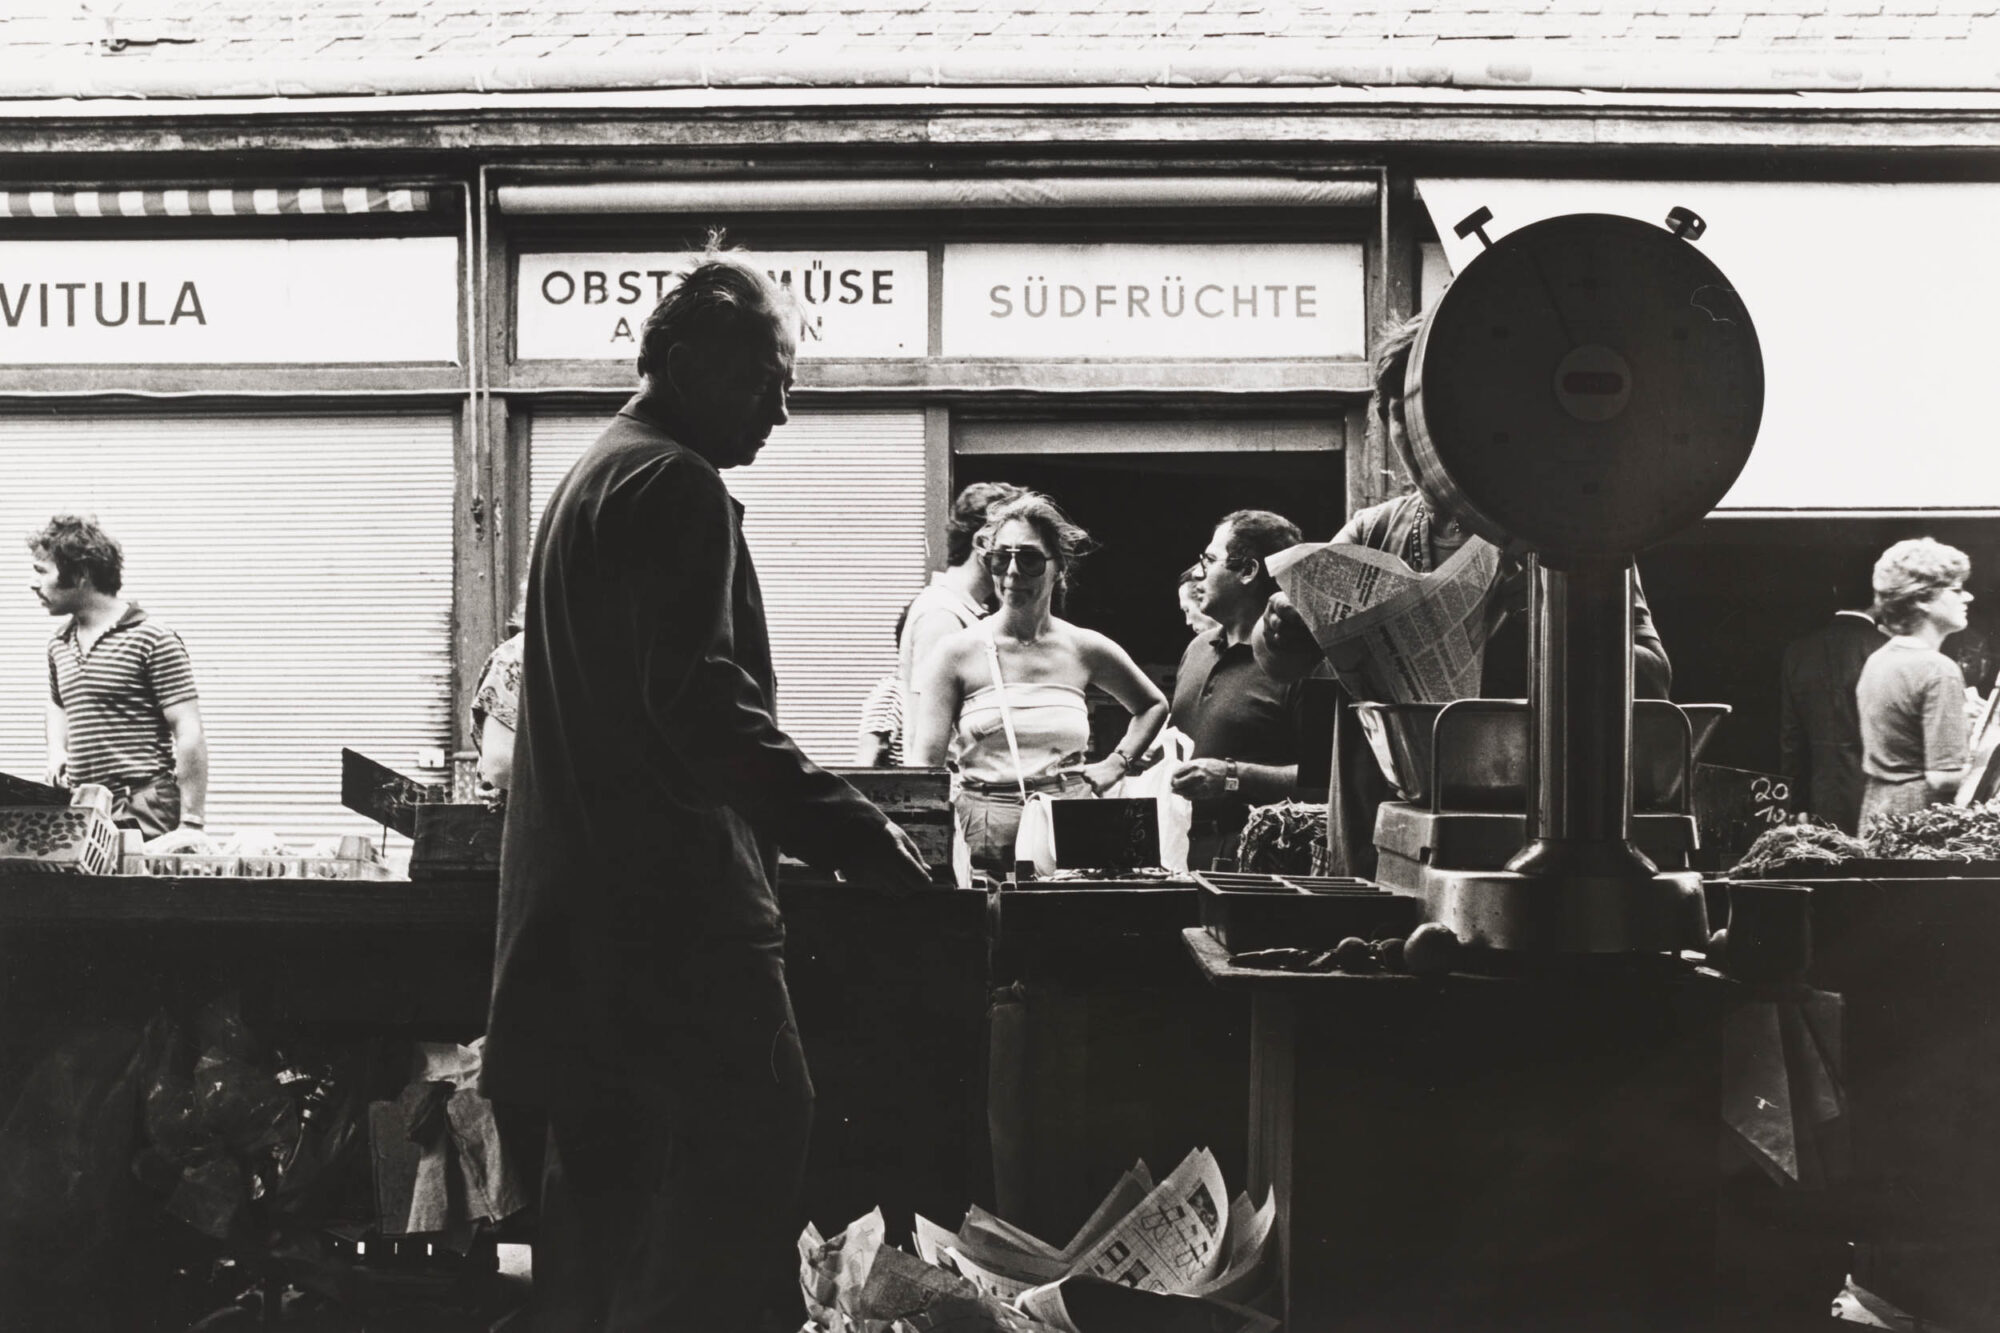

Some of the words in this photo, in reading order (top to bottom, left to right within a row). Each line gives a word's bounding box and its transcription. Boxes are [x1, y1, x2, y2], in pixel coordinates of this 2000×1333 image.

[0, 281, 207, 328] VITULA
[541, 270, 673, 305] OBST
[989, 275, 1317, 319] SÜDFRÜCHTE
[1751, 777, 1789, 802] 20
